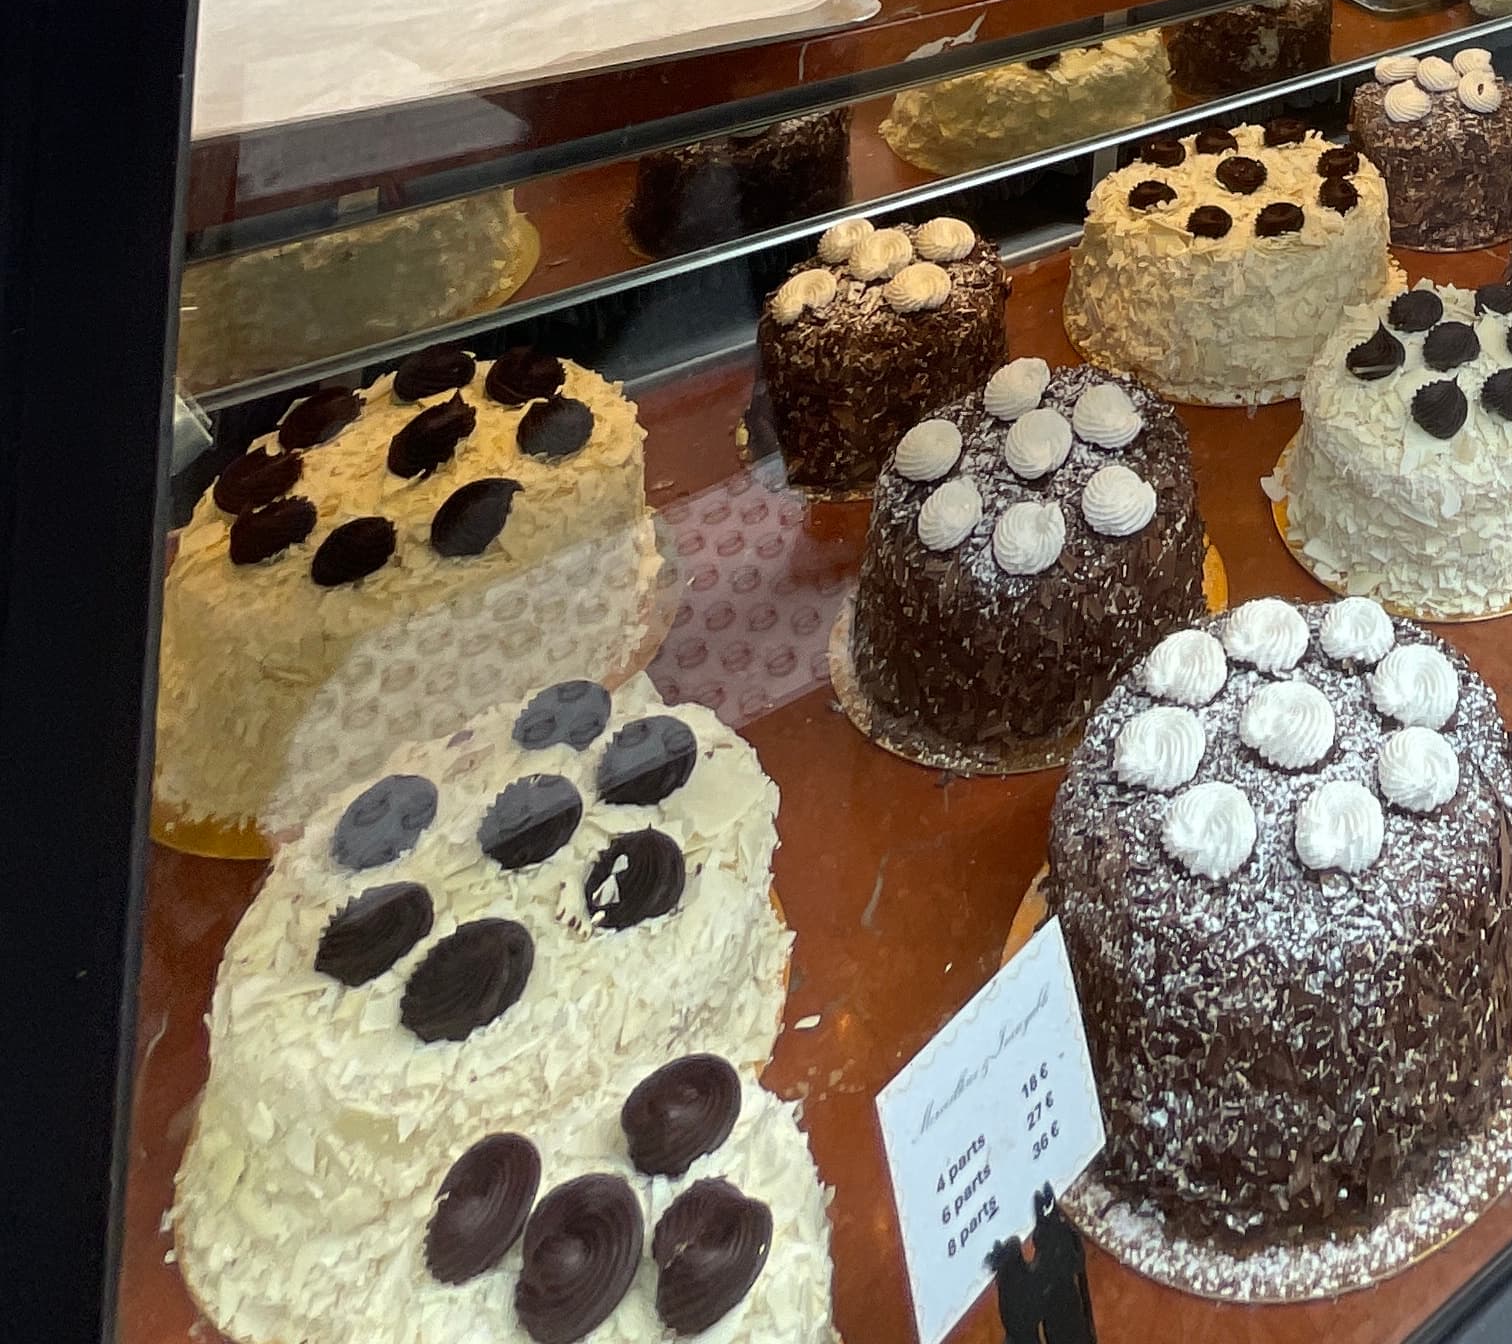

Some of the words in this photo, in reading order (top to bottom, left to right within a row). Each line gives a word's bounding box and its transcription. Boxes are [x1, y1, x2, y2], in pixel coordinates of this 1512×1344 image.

[1021, 1073, 1038, 1099] 18
[1026, 1101, 1042, 1131] 27
[947, 1133, 986, 1185] parts
[1032, 1132, 1049, 1160] 36
[953, 1164, 992, 1216] parts
[959, 1195, 998, 1249] parts
